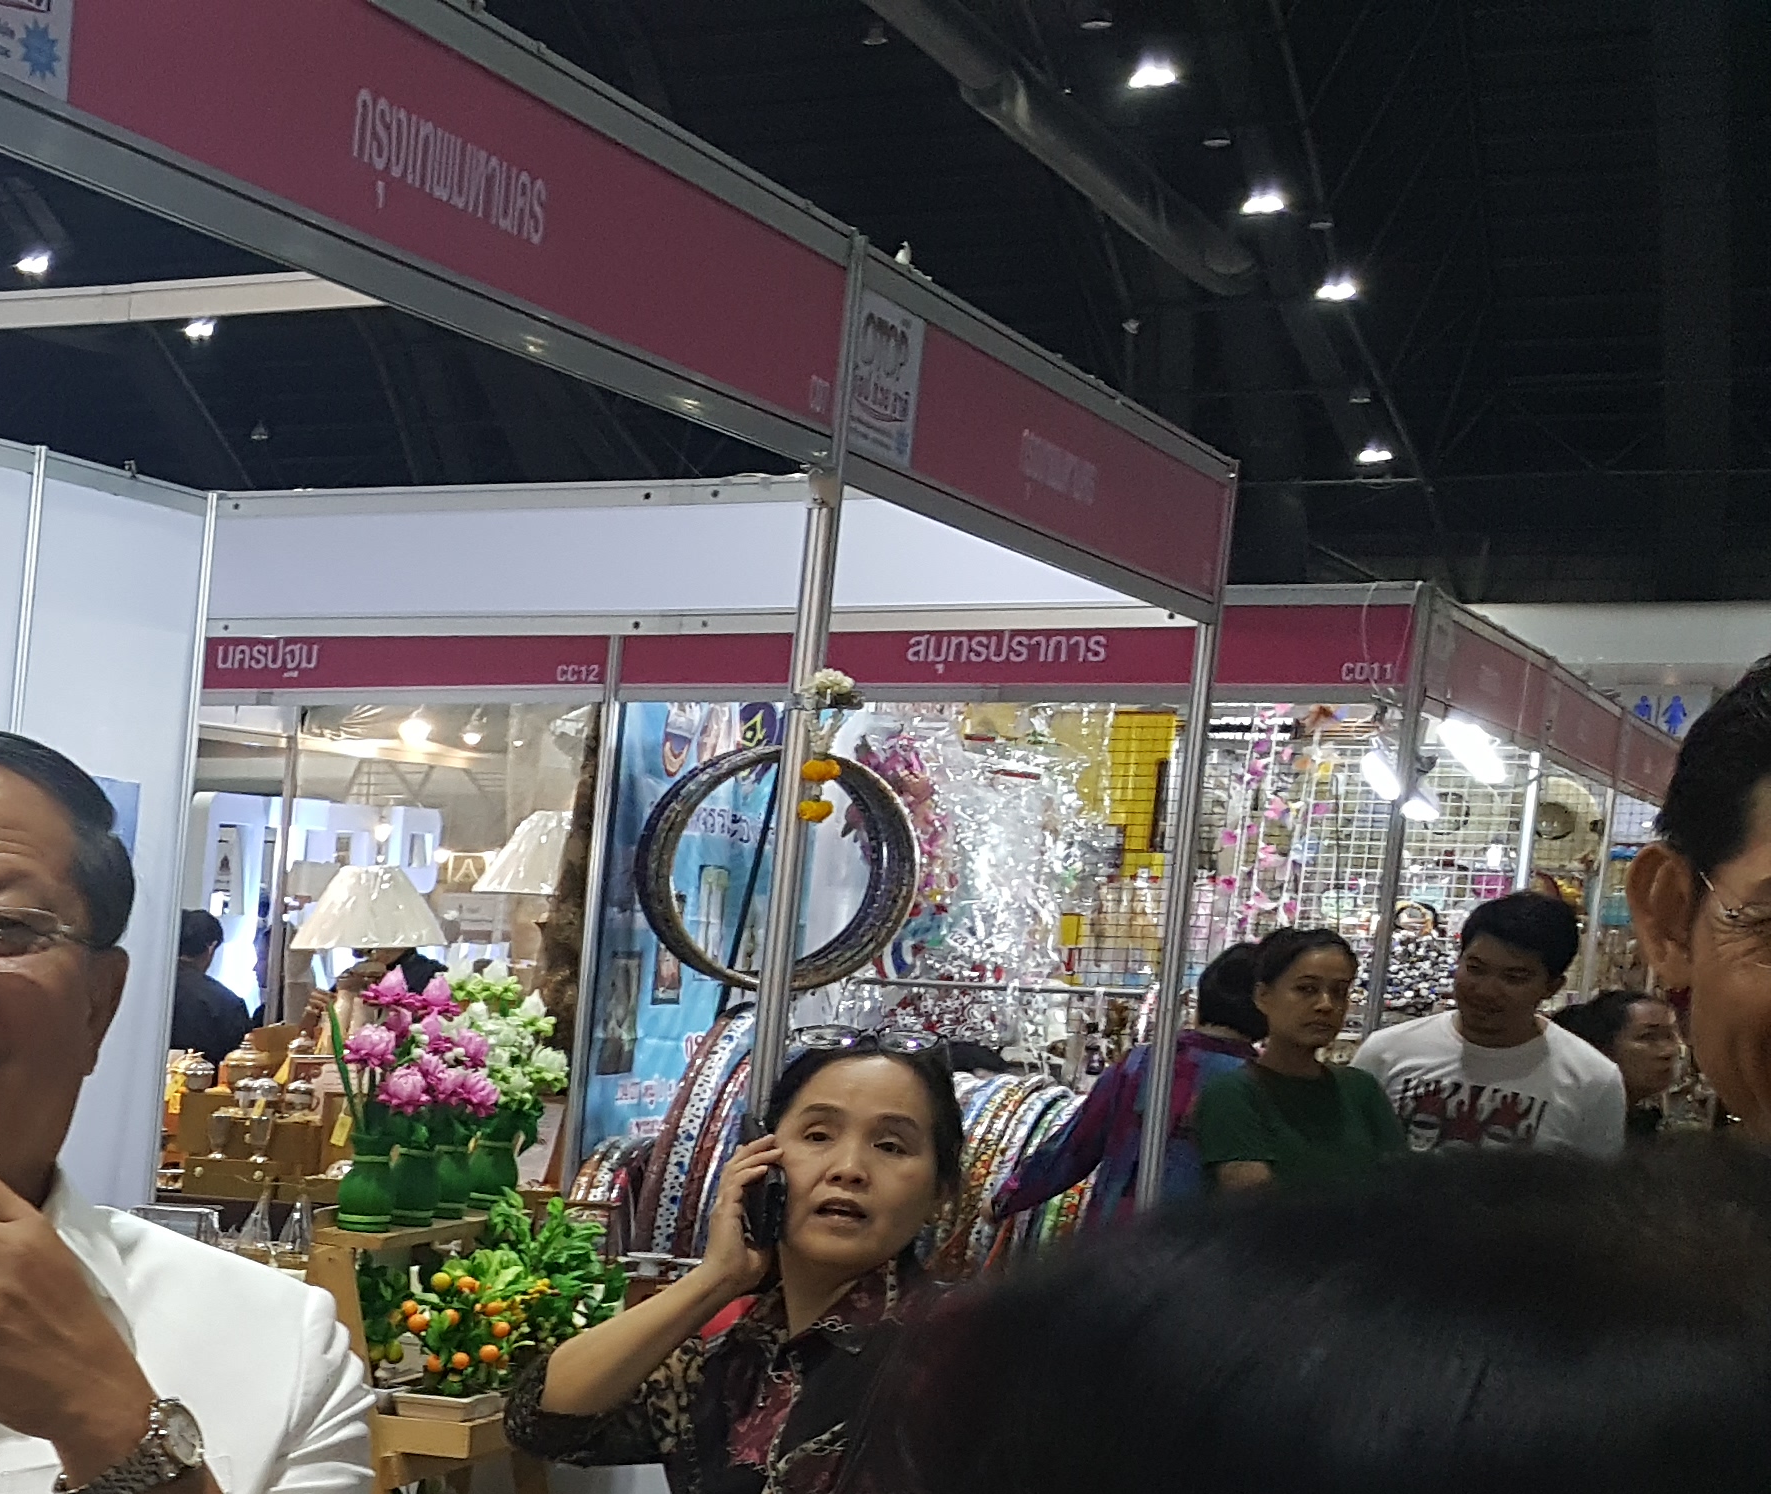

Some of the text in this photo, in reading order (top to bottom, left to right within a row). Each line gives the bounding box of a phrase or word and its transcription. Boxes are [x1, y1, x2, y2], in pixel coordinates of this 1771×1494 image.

[353, 88, 546, 244] กรุงเทพมหานคร
[217, 640, 318, 678] นครปฐม
[557, 664, 599, 682] CC12
[906, 630, 1107, 675] สมุทรปราการ
